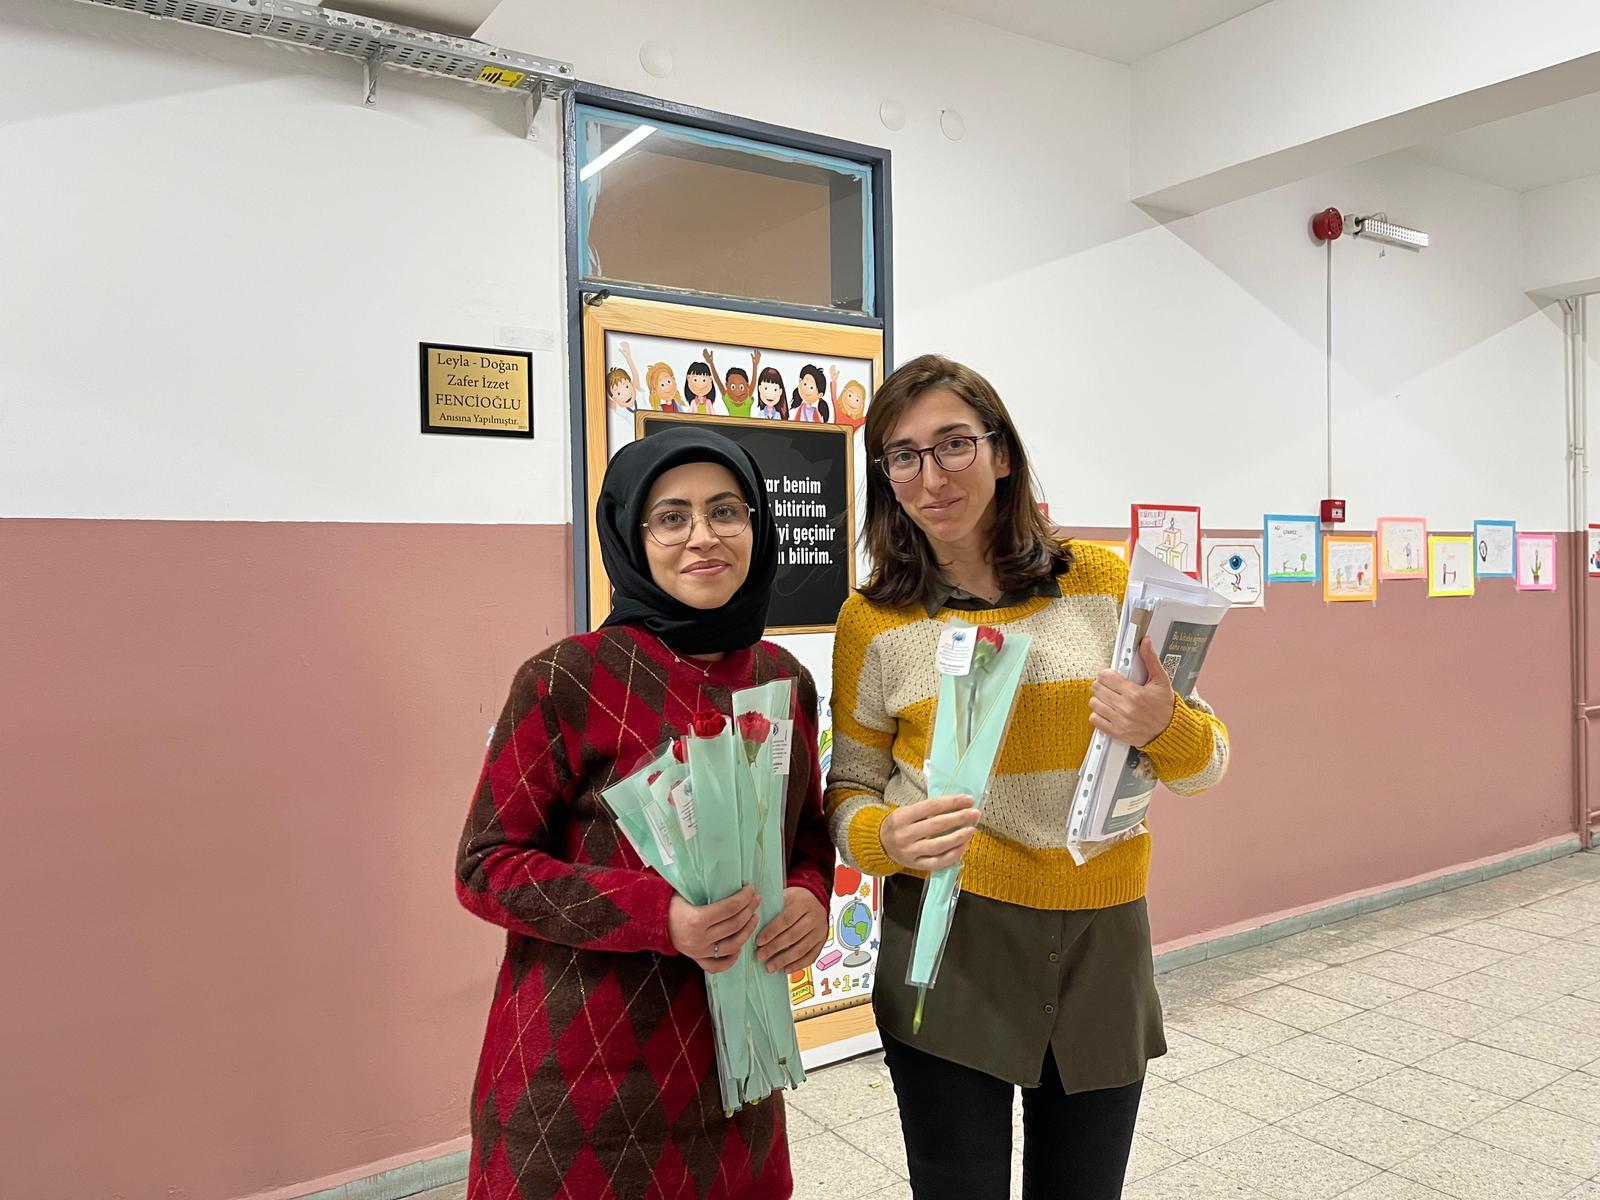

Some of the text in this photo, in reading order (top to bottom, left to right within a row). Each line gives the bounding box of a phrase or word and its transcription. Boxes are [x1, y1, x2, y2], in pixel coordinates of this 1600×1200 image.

[437, 353, 469, 369] Leyla
[480, 357, 519, 373] Doğan
[447, 374, 509, 390] Zafer İzzet
[435, 393, 521, 410] FENCİOĞLU
[439, 412, 519, 426] Anısına Yapılmıştır.
[783, 475, 821, 494] benim
[774, 500, 827, 518] bitiririm
[793, 523, 836, 546] geçinir
[788, 547, 833, 565] bilirim.
